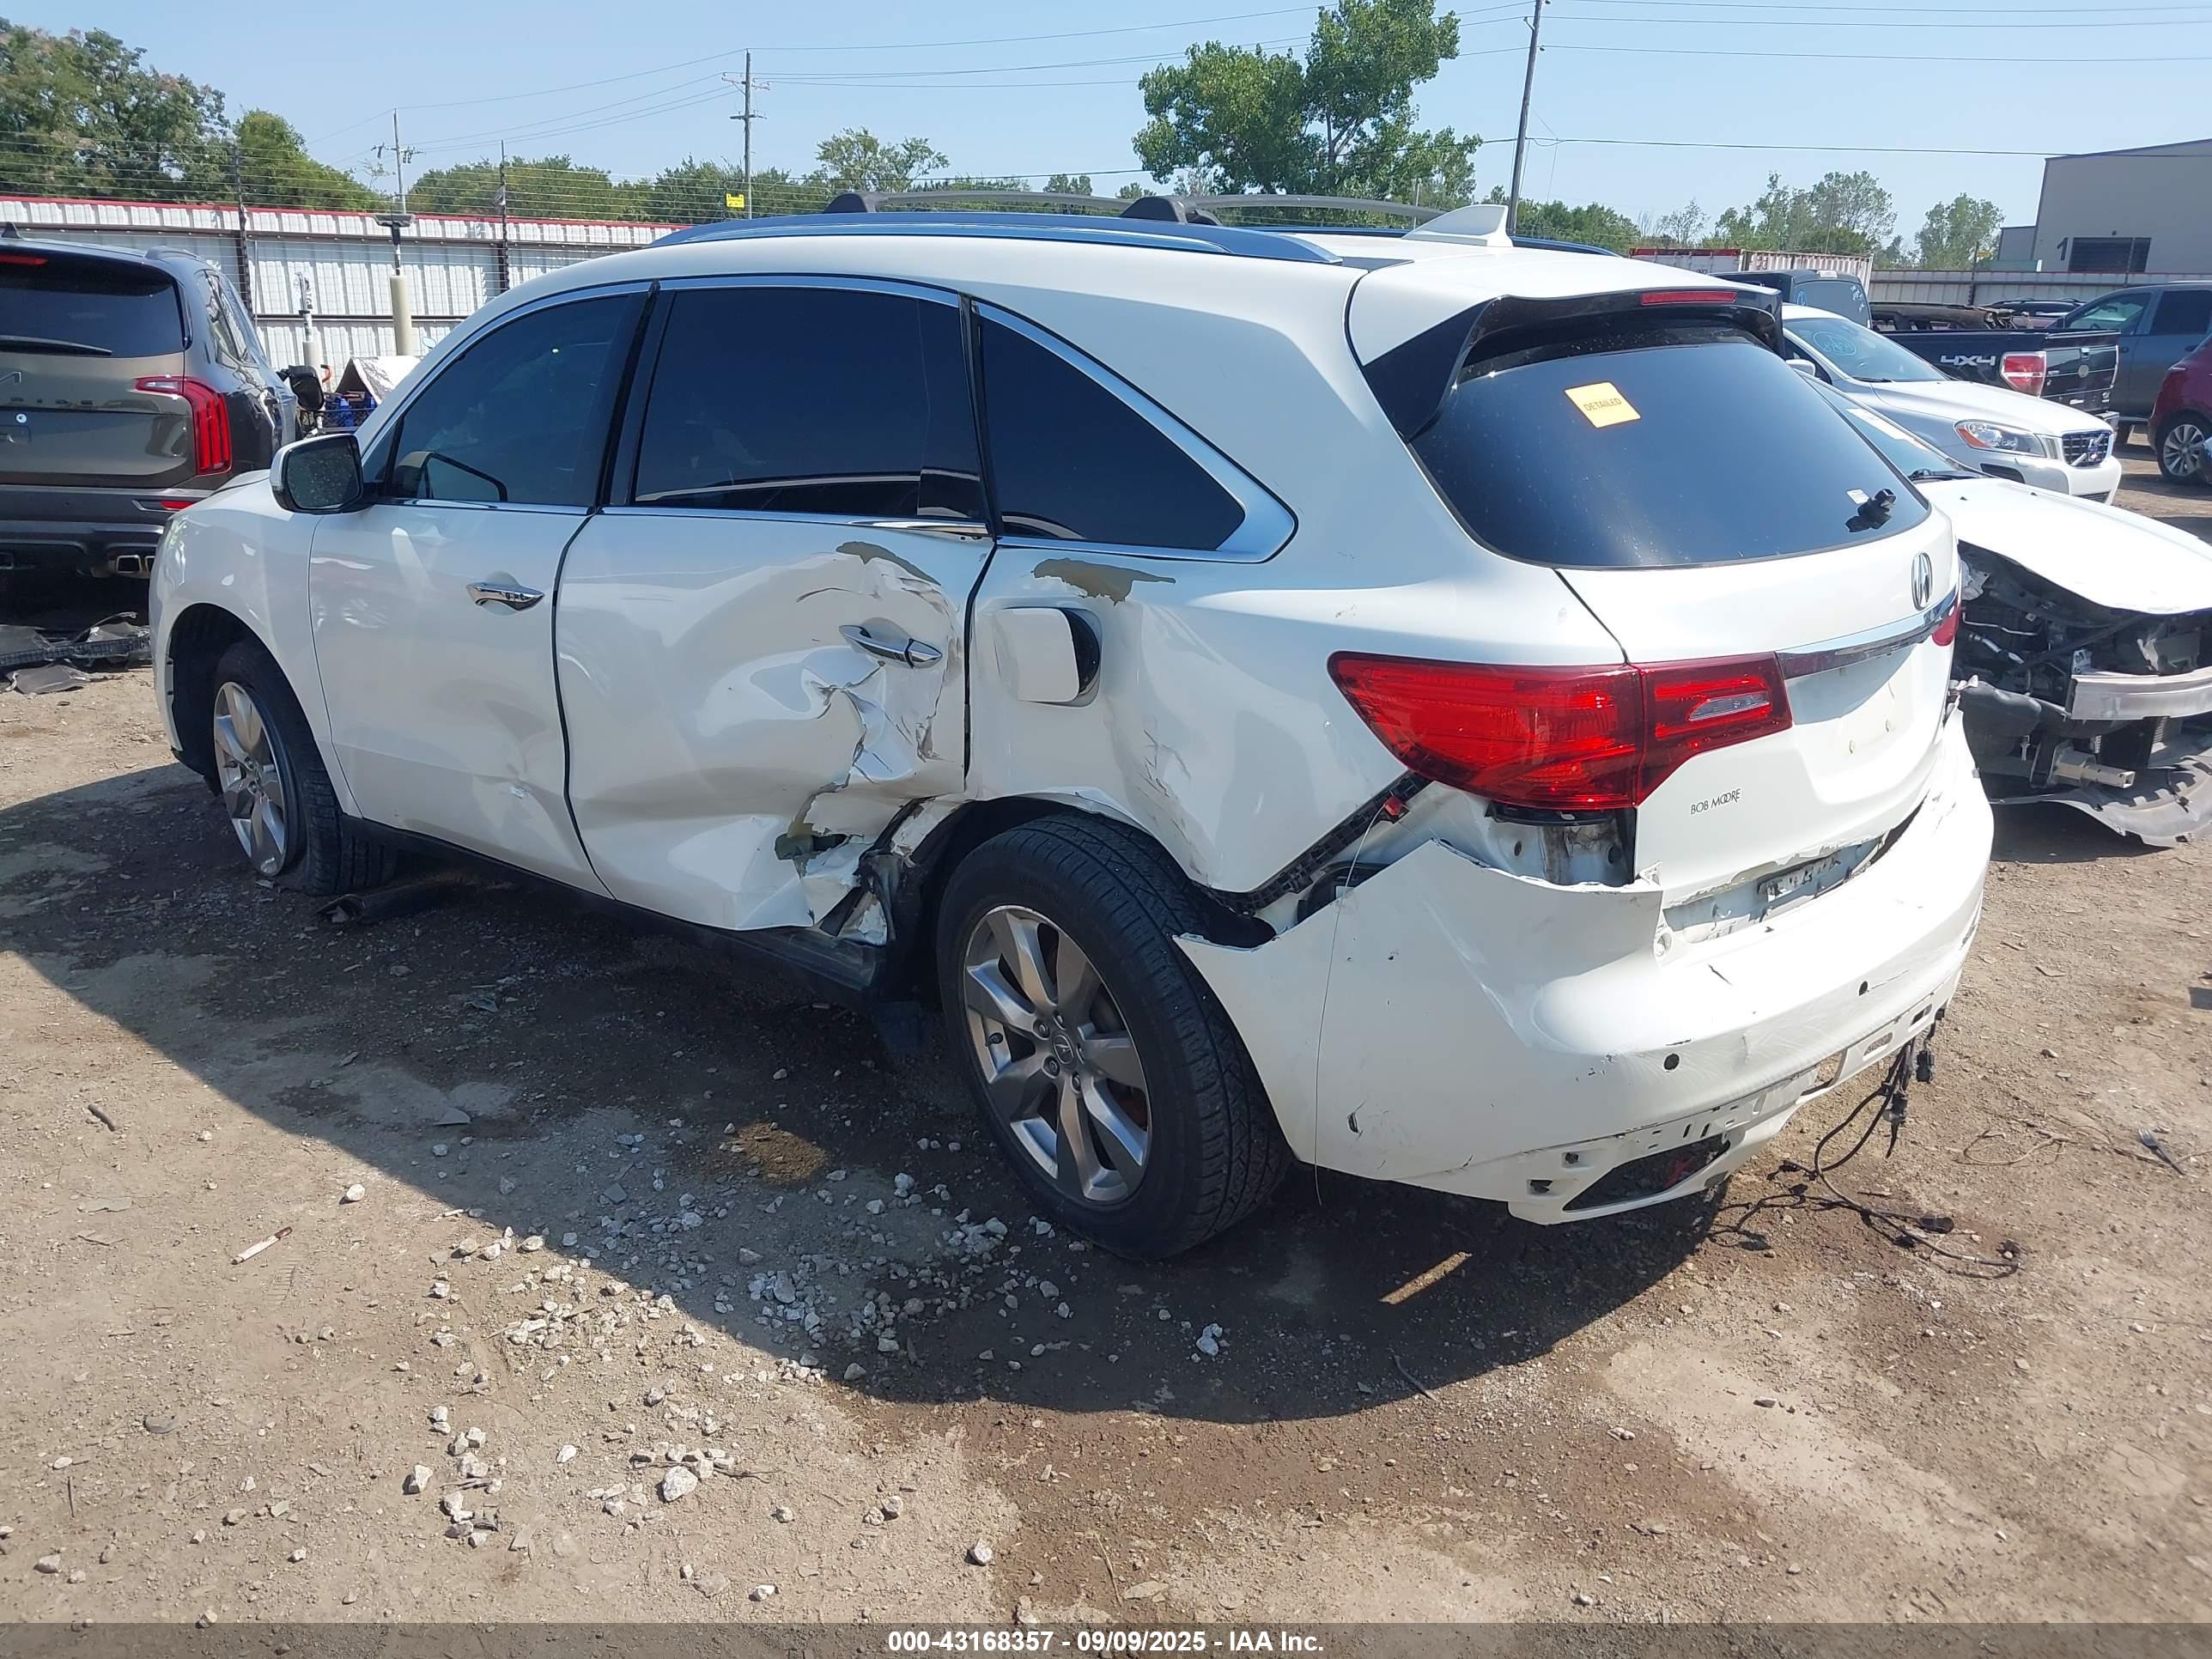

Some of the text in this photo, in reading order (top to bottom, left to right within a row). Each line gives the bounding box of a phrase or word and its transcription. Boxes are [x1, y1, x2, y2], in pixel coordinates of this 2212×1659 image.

[2057, 237, 2069, 261] 1
[1941, 355, 1996, 367] 4X4
[1583, 398, 1622, 411] DETAILED
[1690, 788, 1741, 815] BOB MOORE
